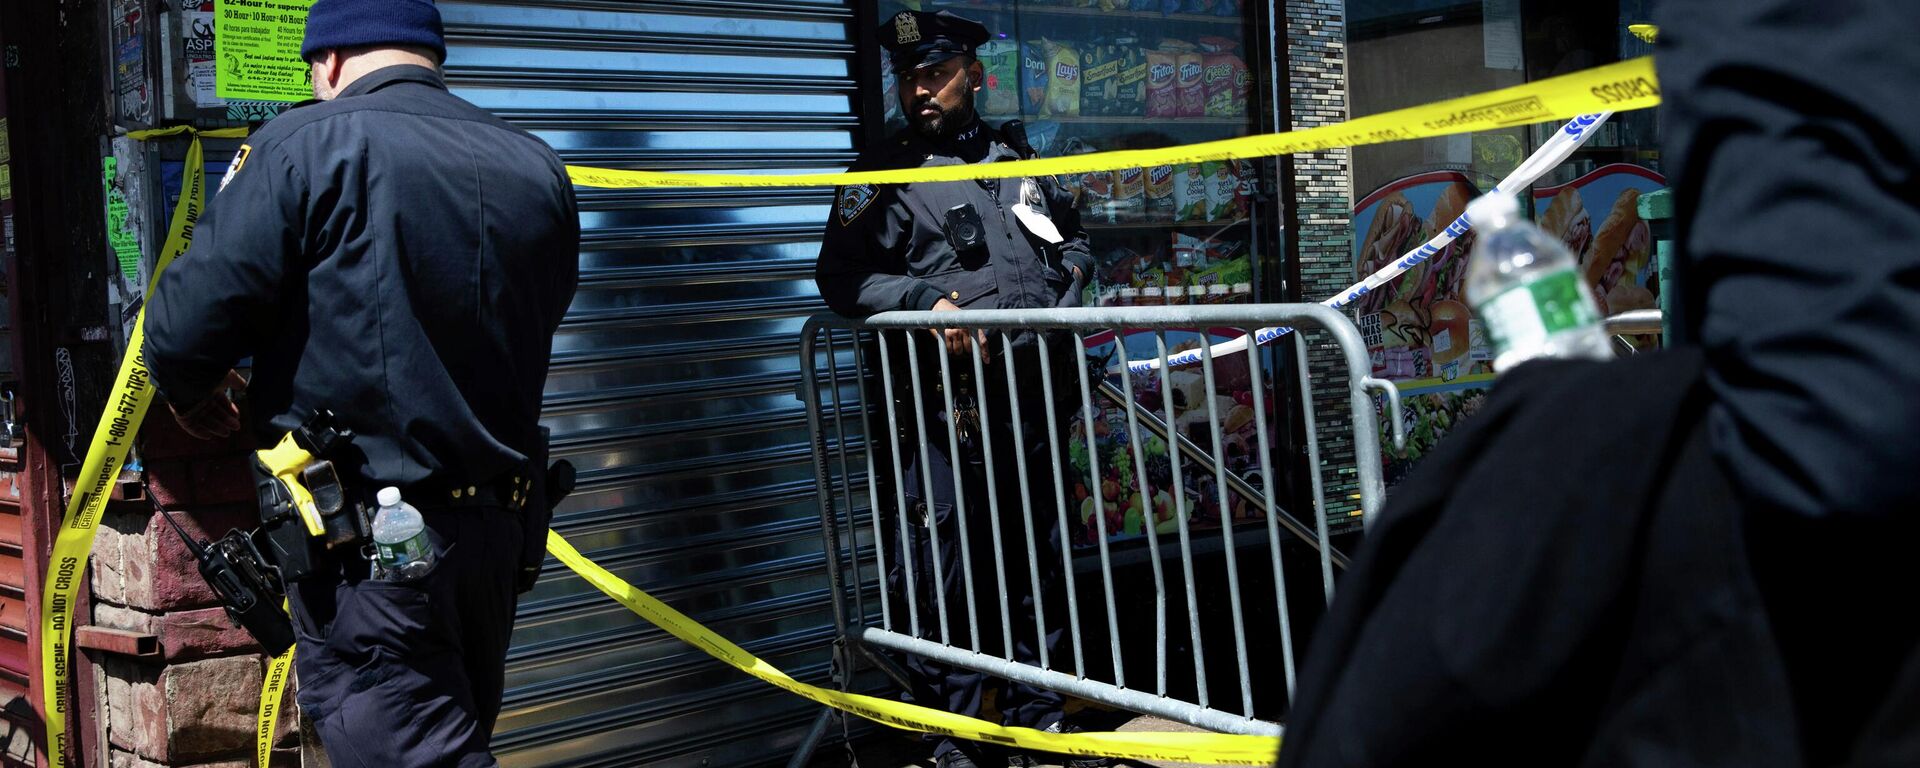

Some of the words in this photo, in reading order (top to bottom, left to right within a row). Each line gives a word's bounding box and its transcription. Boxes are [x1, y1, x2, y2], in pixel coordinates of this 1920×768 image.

[224, 9, 232, 18] 30
[1056, 62, 1078, 80] Lay's
[1150, 63, 1175, 82] Fritos
[186, 202, 199, 224] NOT
[181, 225, 193, 240] DO
[1360, 314, 1380, 326] TEDZ
[1362, 324, 1382, 336] WAS
[1364, 334, 1382, 346] HERE
[105, 368, 149, 446] 1-800-577-TIPS
[54, 556, 78, 590] CROSS
[52, 592, 66, 614] NOT
[54, 615, 64, 630] DO
[54, 642, 64, 678] SCENE
[268, 662, 285, 693] SCENE
[56, 680, 66, 714] CRIME
[264, 704, 274, 717] DO
[261, 720, 270, 739] NOT
